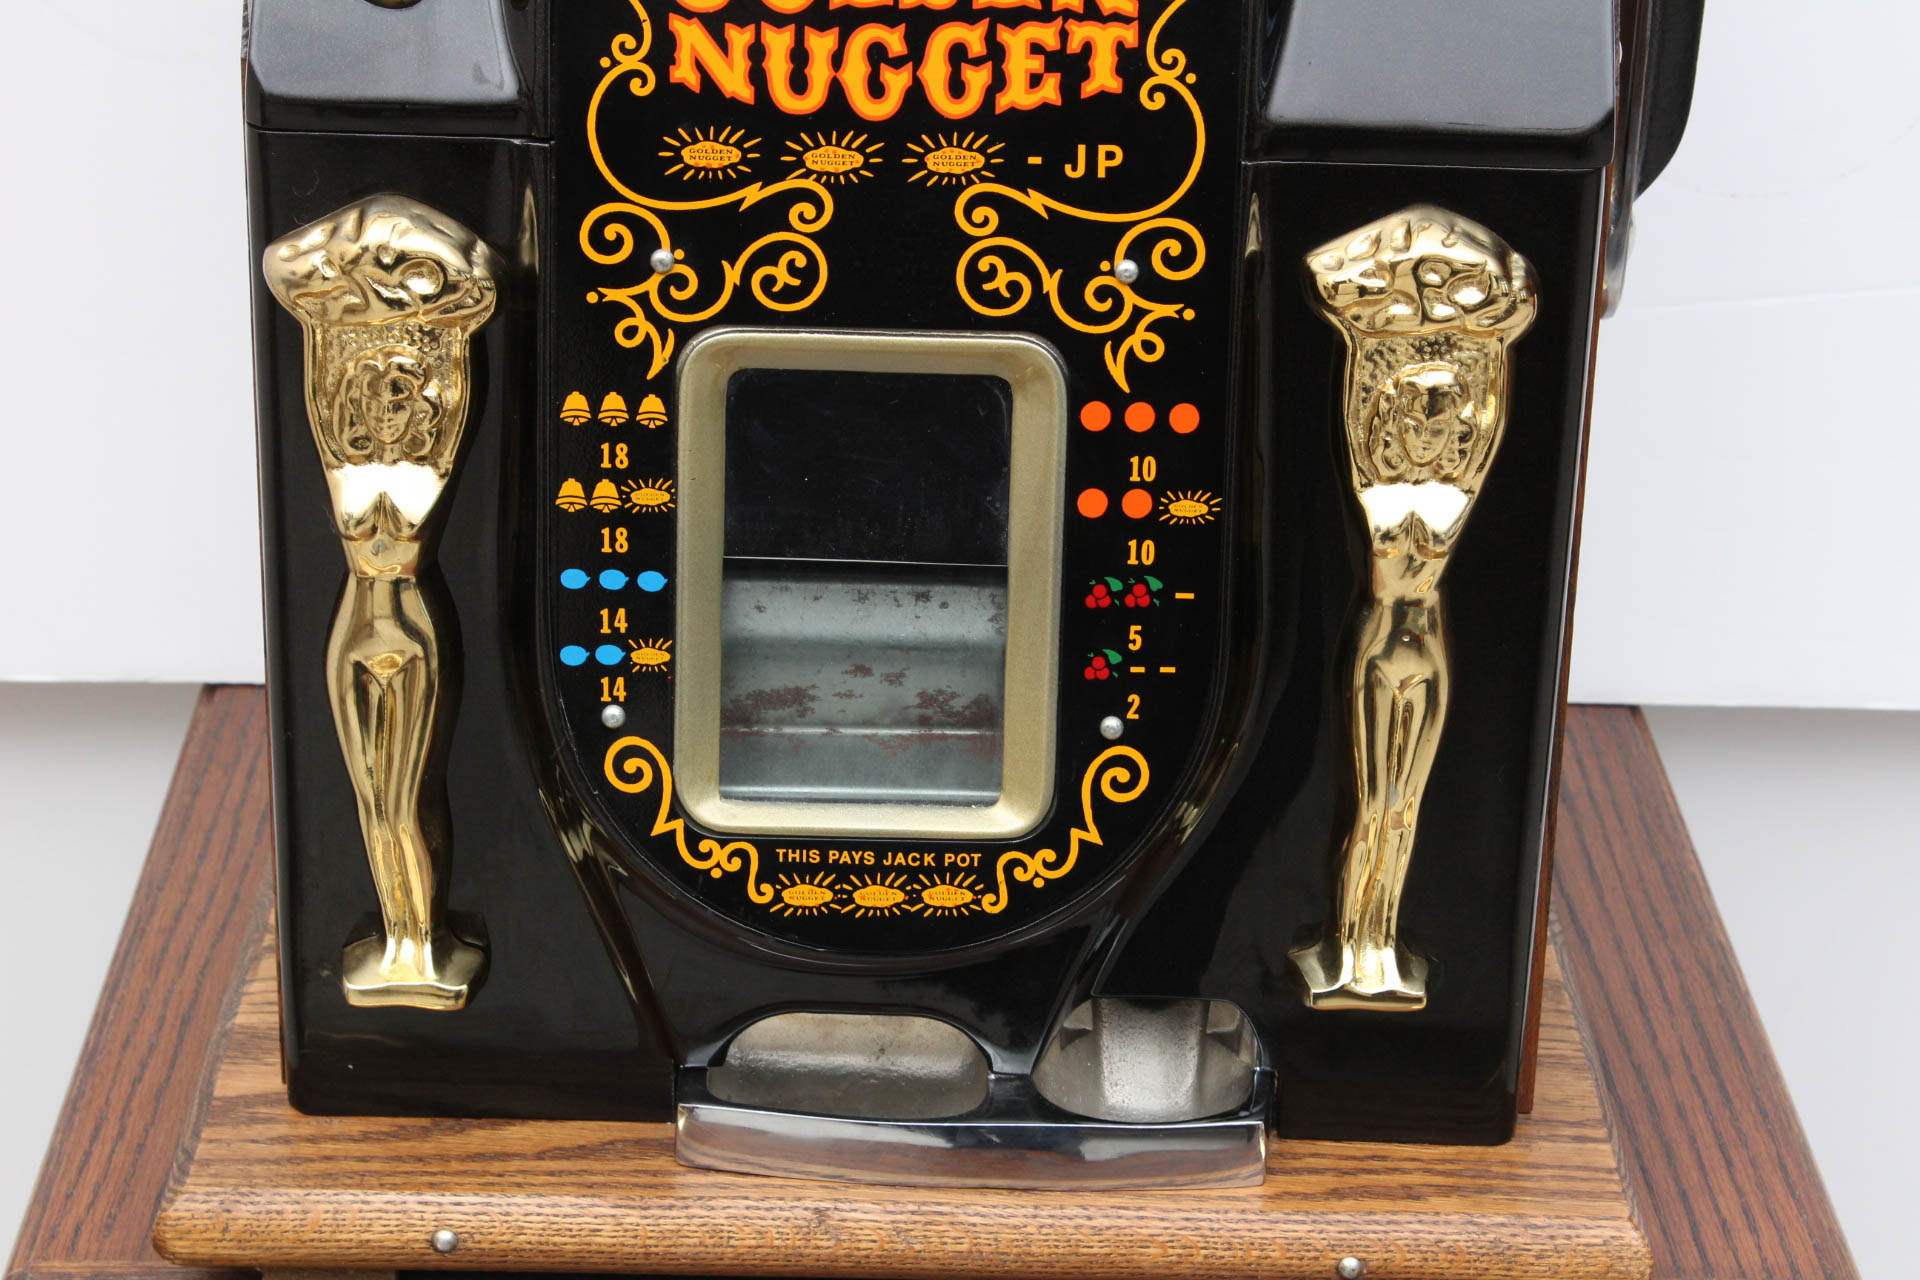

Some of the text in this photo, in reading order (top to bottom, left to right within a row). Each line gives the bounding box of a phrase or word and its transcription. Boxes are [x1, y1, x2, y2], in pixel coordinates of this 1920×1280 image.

[669, 12, 1138, 121] NUGGET
[1064, 144, 1124, 179] JP
[600, 442, 629, 469] 18
[1129, 455, 1157, 482] 10
[600, 527, 629, 553] 18
[1127, 539, 1155, 566] 10
[600, 608, 628, 634] 14
[1128, 625, 1142, 651] 5
[600, 676, 627, 702] 14
[1126, 693, 1141, 720] 2
[776, 848, 982, 867] THIS PAYS JACK POT
